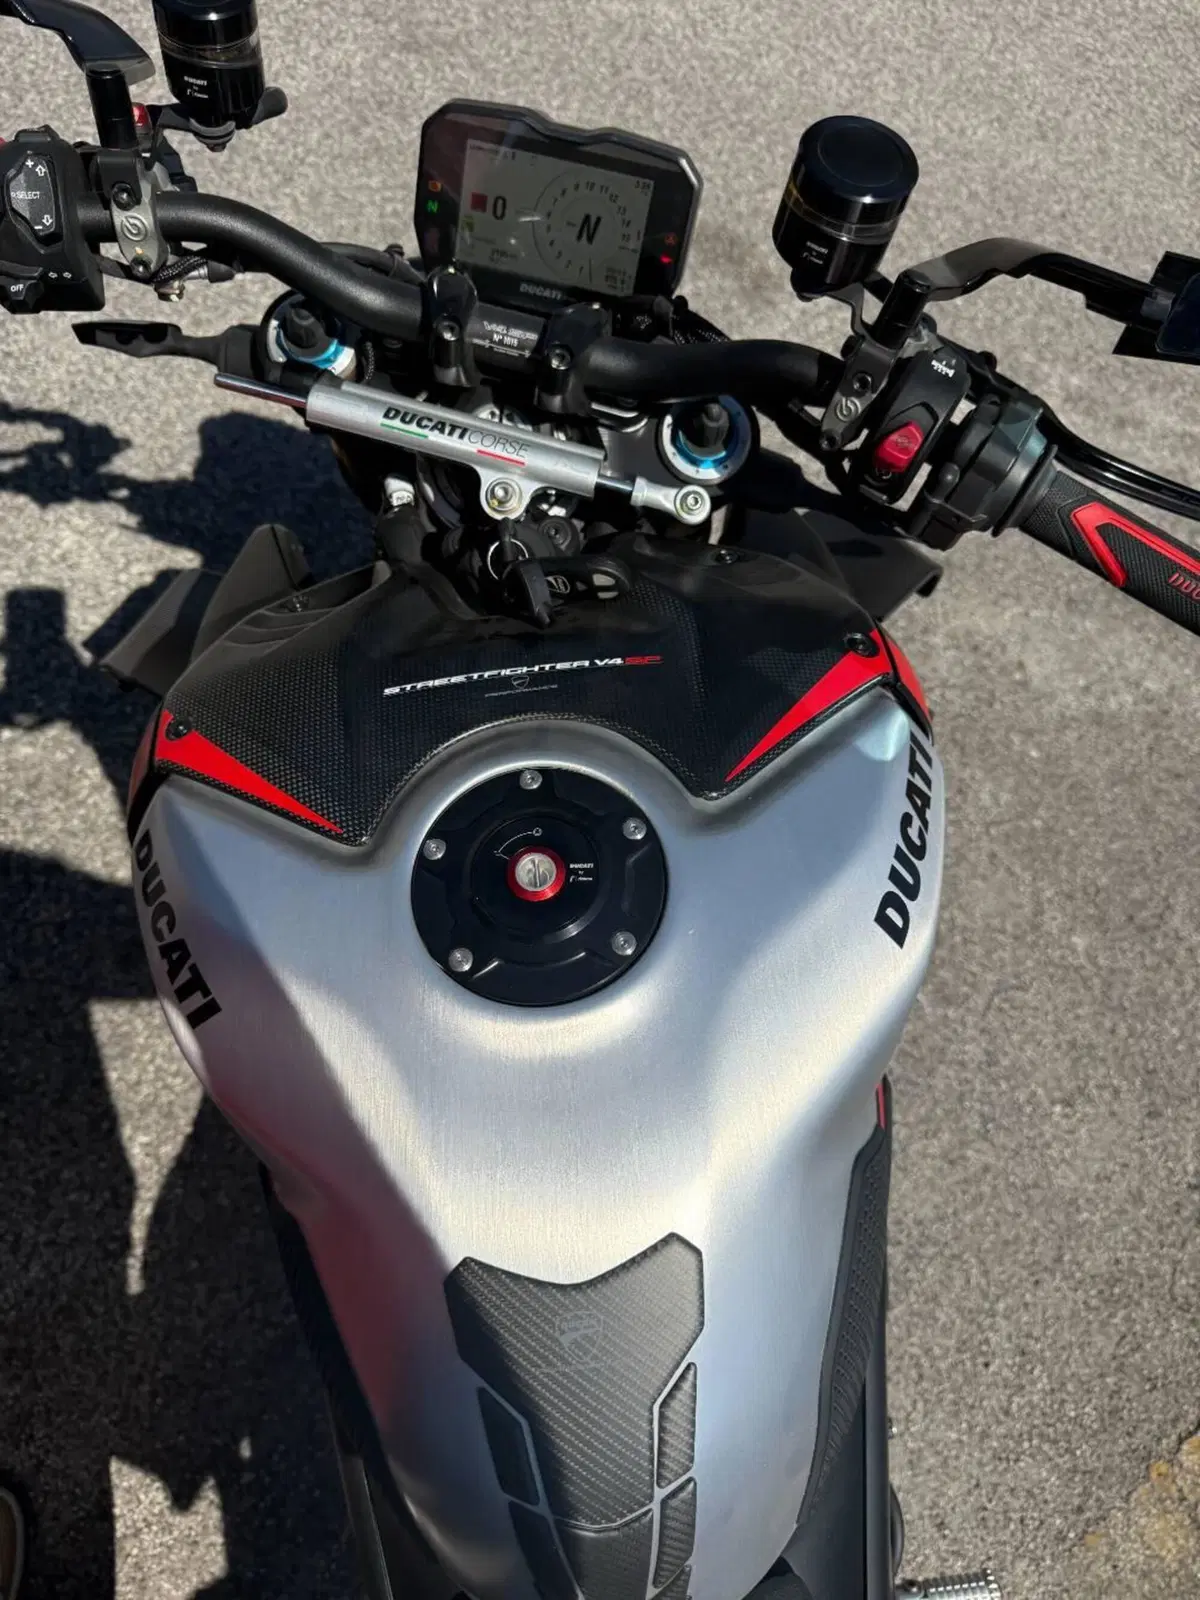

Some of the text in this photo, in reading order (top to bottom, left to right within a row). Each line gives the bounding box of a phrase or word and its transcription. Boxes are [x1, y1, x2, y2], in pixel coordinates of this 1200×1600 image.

[16, 191, 40, 199] SELECT
[576, 213, 602, 245] N
[10, 284, 24, 292] OFF
[519, 281, 562, 300] DUCATI
[383, 659, 590, 696] STREETFIGHTER
[872, 730, 933, 949] DUCATI
[135, 829, 222, 1029] DUCATI
